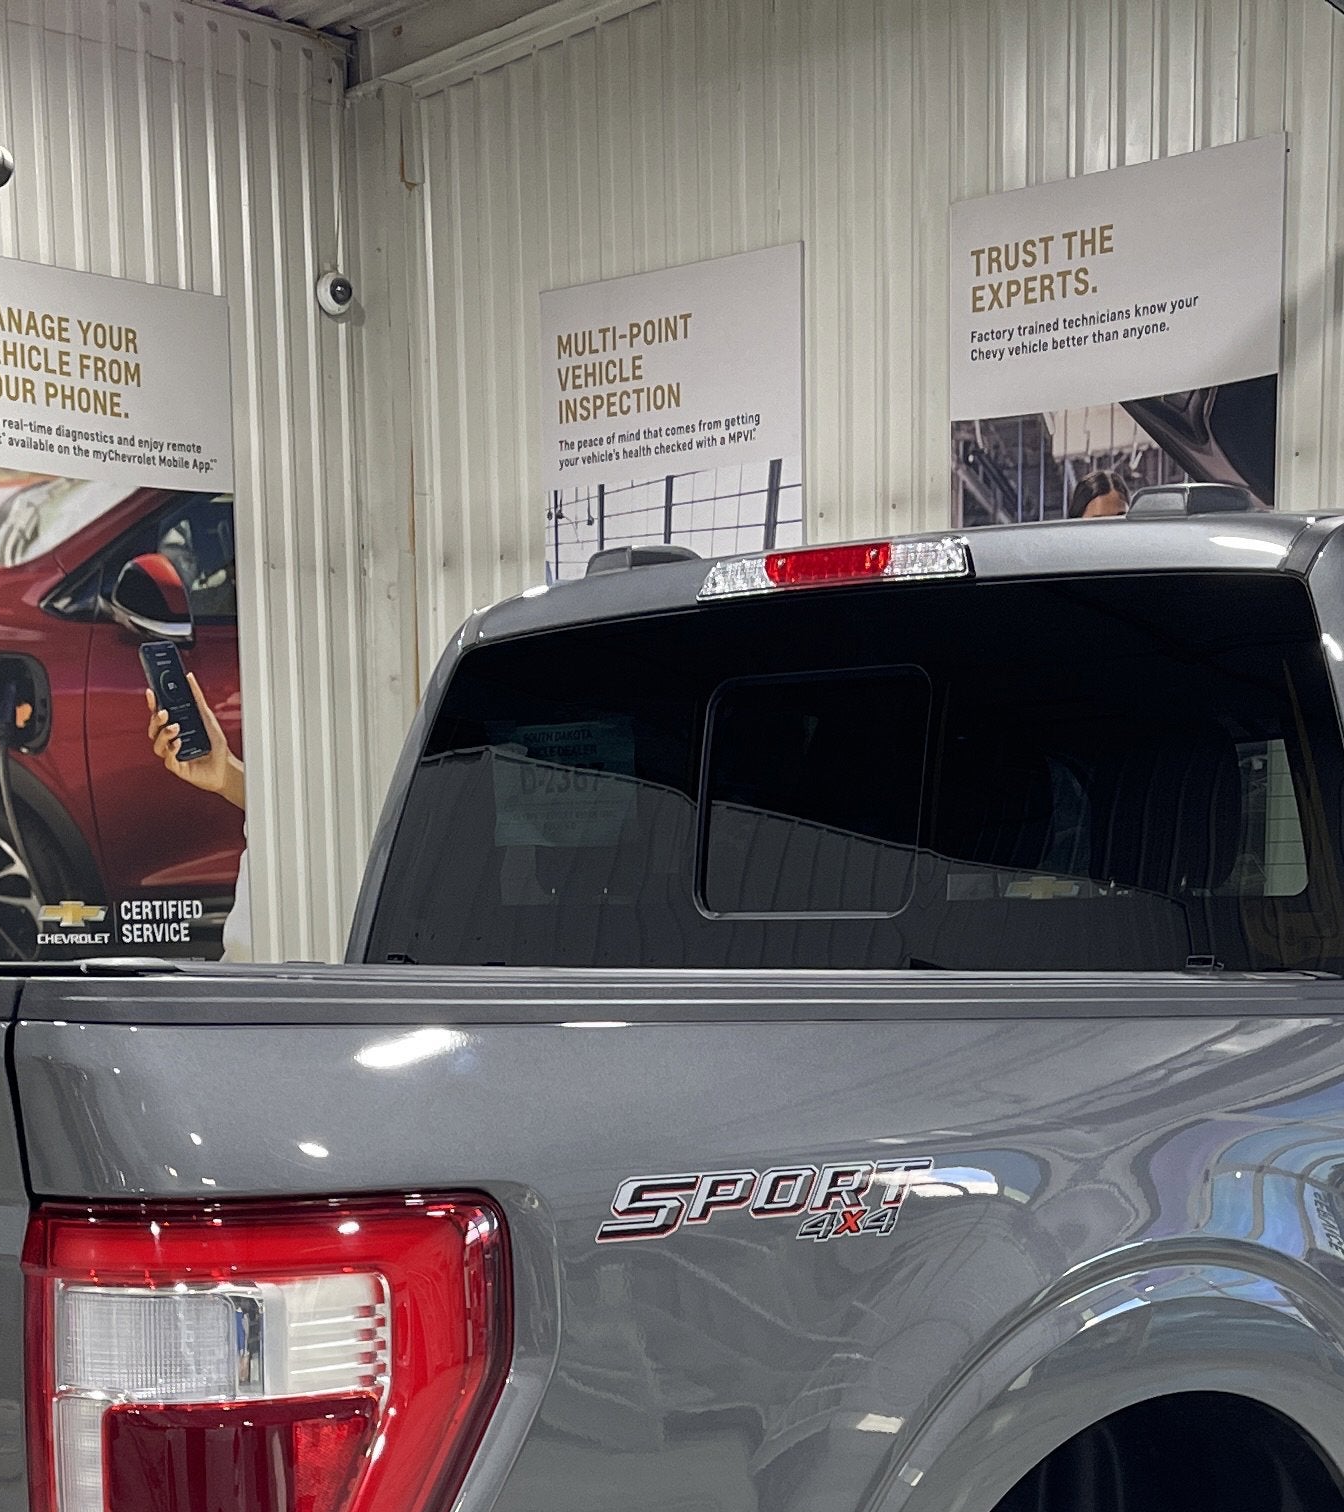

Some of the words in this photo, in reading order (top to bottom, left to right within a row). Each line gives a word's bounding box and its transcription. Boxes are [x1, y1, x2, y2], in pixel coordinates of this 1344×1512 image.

[969, 235, 1054, 277] TRUST
[1061, 223, 1115, 261] THE
[971, 265, 1098, 314] EXPERTS.
[76, 318, 139, 354] YOUR
[556, 312, 693, 360] MULTI-POINT
[970, 327, 1015, 343] Factory
[1017, 317, 1059, 337] trained
[1062, 308, 1131, 330] technicians
[1134, 301, 1168, 318] know
[1170, 295, 1199, 315] your
[970, 346, 1005, 362] Chevy
[1007, 338, 1049, 356] vehicle
[1051, 333, 1089, 350] better
[1092, 329, 1119, 344] than
[1122, 321, 1170, 340] anyone.
[78, 353, 142, 388] FROM
[557, 353, 644, 392] VEHICLE
[43, 381, 129, 419] PHONE.
[558, 381, 682, 425] INSPECTION
[2, 418, 53, 436] real-time
[55, 424, 114, 444] diagnostics
[116, 434, 135, 447] and
[137, 437, 165, 453] enjoy
[166, 441, 202, 454] remote
[558, 439, 575, 452] The
[577, 436, 604, 452] peace
[606, 431, 616, 445] of
[618, 428, 641, 444] mind
[643, 426, 663, 440] that
[665, 423, 696, 437] comes
[698, 418, 722, 432] from
[724, 412, 761, 431] getting
[7, 436, 55, 453] available
[57, 444, 71, 456] on
[72, 443, 90, 458] the
[92, 448, 157, 466] myChevrolet
[158, 454, 190, 469] Mobile
[558, 456, 580, 471] your
[581, 448, 620, 465] vehicle's
[622, 443, 652, 460] health
[654, 437, 693, 456] checked
[695, 434, 717, 449] with
[719, 436, 726, 446] a
[120, 899, 204, 921] CERTIFIED
[36, 932, 111, 945] CHEVROLET
[121, 922, 191, 944] SERVICE
[594, 1156, 935, 1244] SPORT
